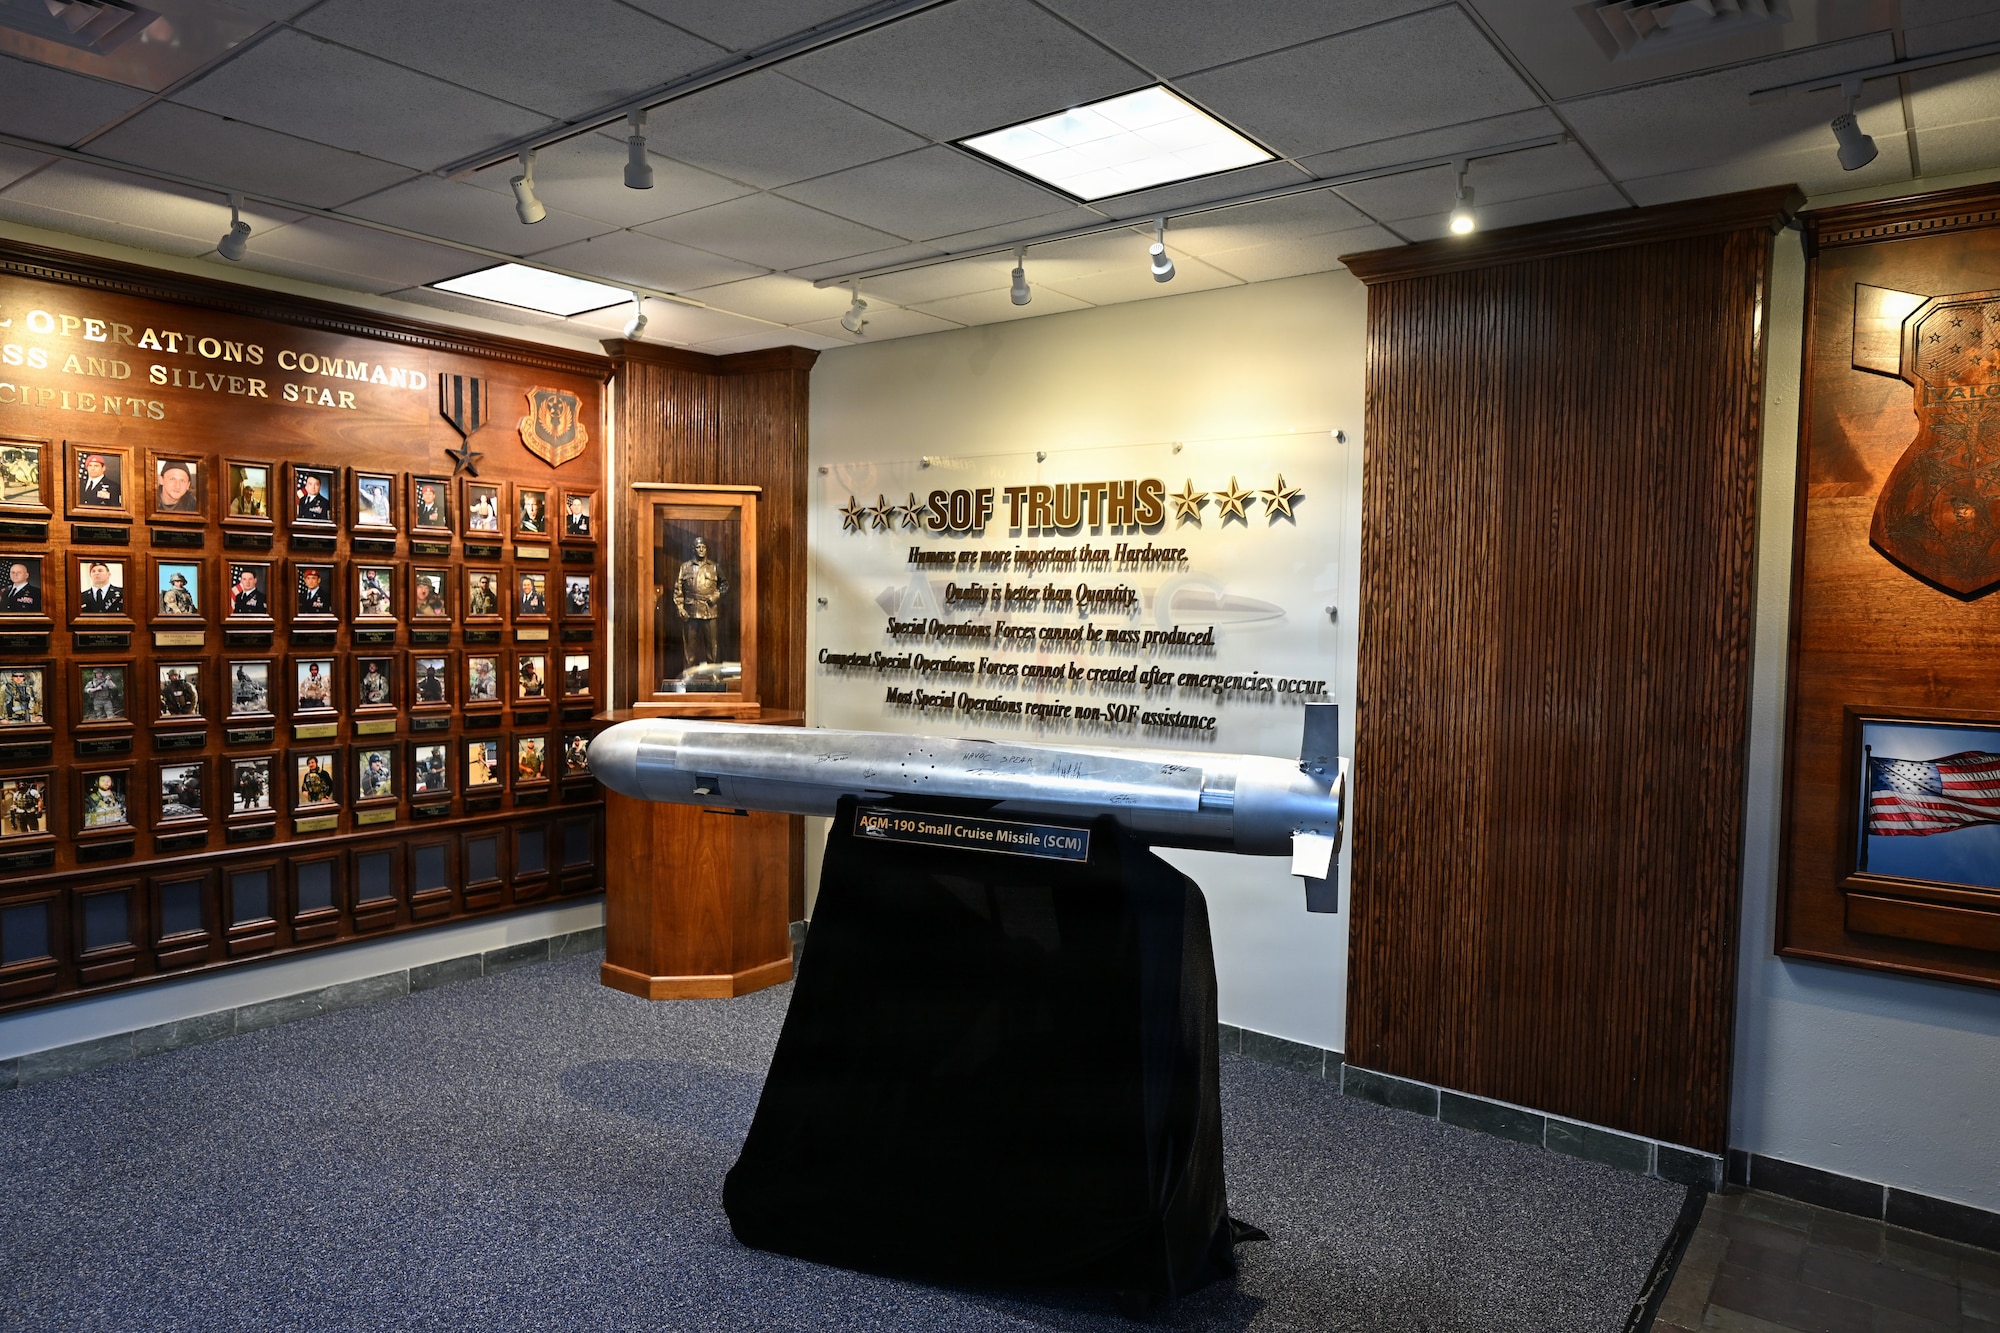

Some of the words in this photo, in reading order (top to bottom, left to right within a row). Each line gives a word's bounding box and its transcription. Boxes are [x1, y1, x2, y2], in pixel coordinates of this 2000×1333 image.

[26, 309, 264, 365] OPERATIONS
[277, 348, 428, 391] COMMAND
[62, 353, 132, 380] AND
[149, 364, 269, 398] SILVER
[283, 384, 357, 410] STAR
[927, 487, 994, 532] SOF
[1003, 478, 1165, 530] TRUTHS
[908, 546, 956, 564] Humans
[958, 550, 977, 563] are
[980, 550, 1011, 563] more
[1014, 545, 1076, 568] important
[1079, 543, 1110, 562] than
[1114, 542, 1189, 563] Hardware.
[945, 582, 989, 605] Quality
[991, 583, 1003, 600] is
[1004, 582, 1040, 600] better
[1042, 582, 1073, 601] than
[1075, 582, 1138, 607] Quantity.
[886, 617, 927, 639] Special
[928, 618, 992, 640] Operations
[993, 620, 1036, 639] Forces
[1038, 624, 1085, 641] cannot
[1086, 622, 1103, 642] be
[1105, 629, 1140, 645] mass
[1142, 626, 1215, 648] produced.
[818, 648, 872, 669] Competent
[872, 651, 912, 672] Special
[913, 653, 975, 675] Operations
[977, 656, 1019, 676] Forces
[1021, 661, 1067, 680] cannot
[1068, 662, 1084, 681] be
[1086, 665, 1137, 684] created
[1139, 665, 1174, 690] after
[1177, 671, 1273, 695] emergencies
[1277, 675, 1328, 696] occur.
[885, 687, 913, 704] Most
[913, 688, 956, 710] Special
[957, 692, 1022, 715] Operations
[1025, 700, 1071, 721] require
[1074, 703, 1140, 724] non-SOF
[1141, 707, 1216, 730] assistance
[859, 815, 916, 833] AGM-190
[917, 821, 952, 836] Small
[954, 825, 994, 841] Cruise
[995, 829, 1041, 846] Missile
[1043, 834, 1082, 852] (SCM)
